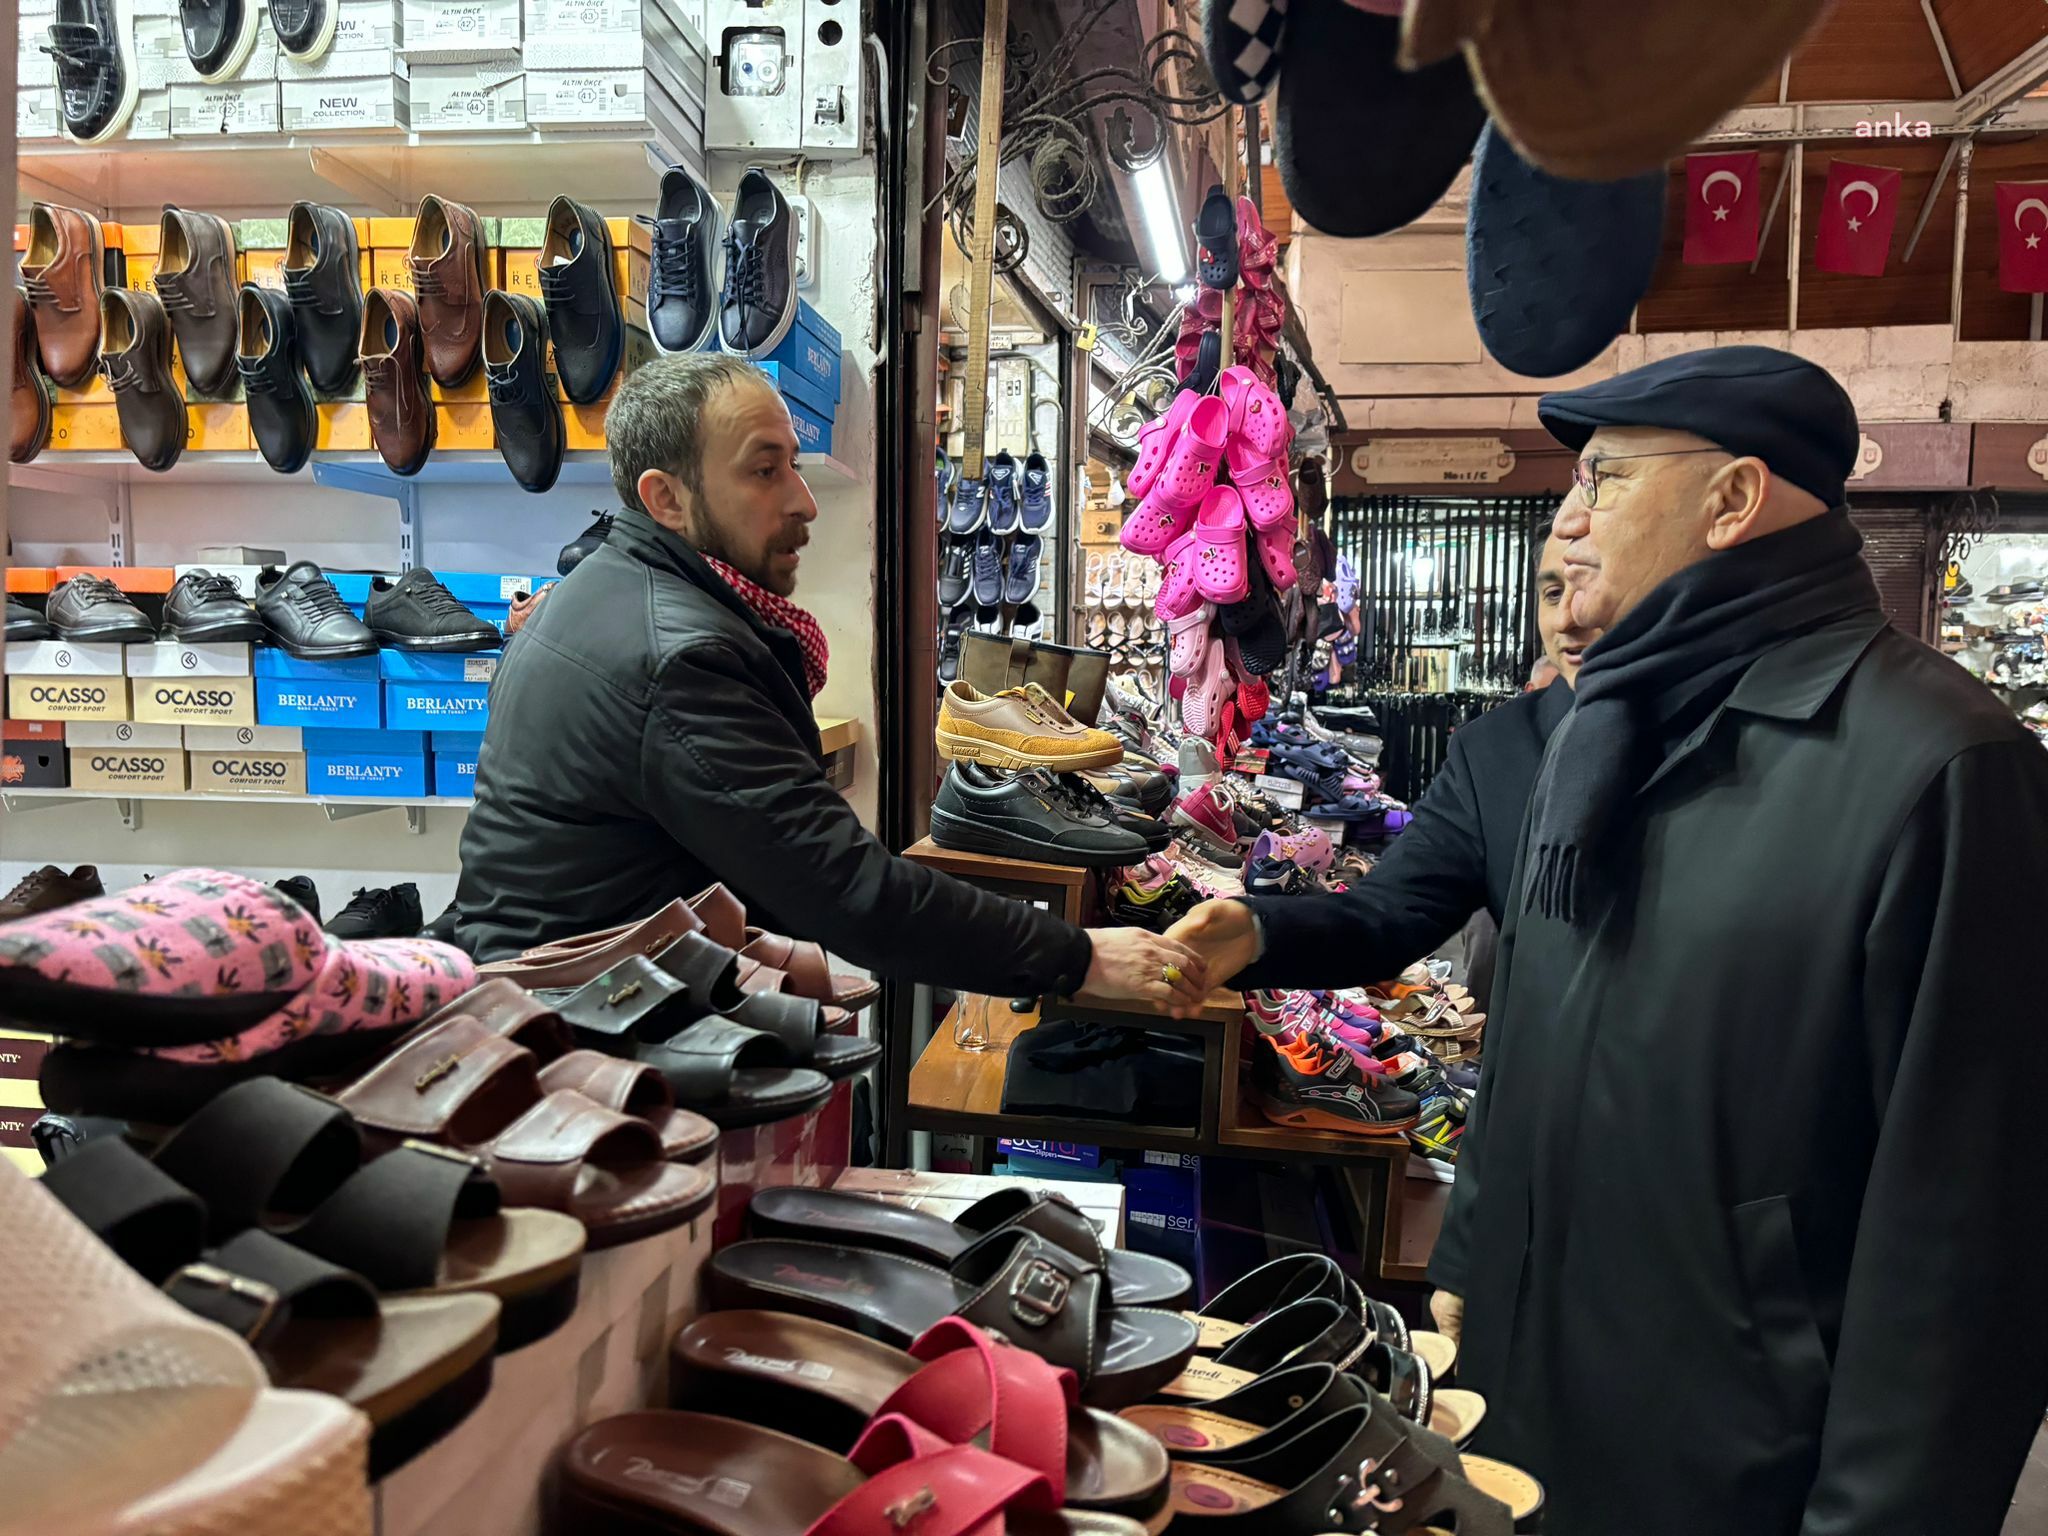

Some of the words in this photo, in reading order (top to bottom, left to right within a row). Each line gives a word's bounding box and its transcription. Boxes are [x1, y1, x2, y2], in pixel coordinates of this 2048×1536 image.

[442, 8, 462, 16] ALTIN
[463, 6, 481, 15] ÖKÇE
[562, 79, 583, 87] ALTIN
[583, 78, 603, 87] ÖKÇE
[204, 94, 224, 102] ALTIN
[472, 90, 490, 98] ÖKÇE
[581, 91, 592, 100] 41
[319, 97, 358, 109] NEW
[469, 102, 480, 112] 44
[313, 109, 366, 118] COLLECTION
[30, 686, 106, 704] OCASSO
[155, 689, 233, 707] OCASSO
[278, 694, 355, 708] BERLANTY
[406, 697, 485, 711] BERLANTY
[82, 705, 106, 713] SPORT
[173, 707, 208, 715] COMFORT
[91, 756, 165, 773] OCASSO
[212, 760, 286, 777] OCASSO
[327, 764, 401, 778] BERLANTY
[108, 773, 142, 781] COMFORT
[142, 774, 165, 782] SPORT
[229, 777, 263, 785] COMFORT
[263, 778, 287, 786] SPORT
[1034, 1148, 1058, 1159] Slippers
